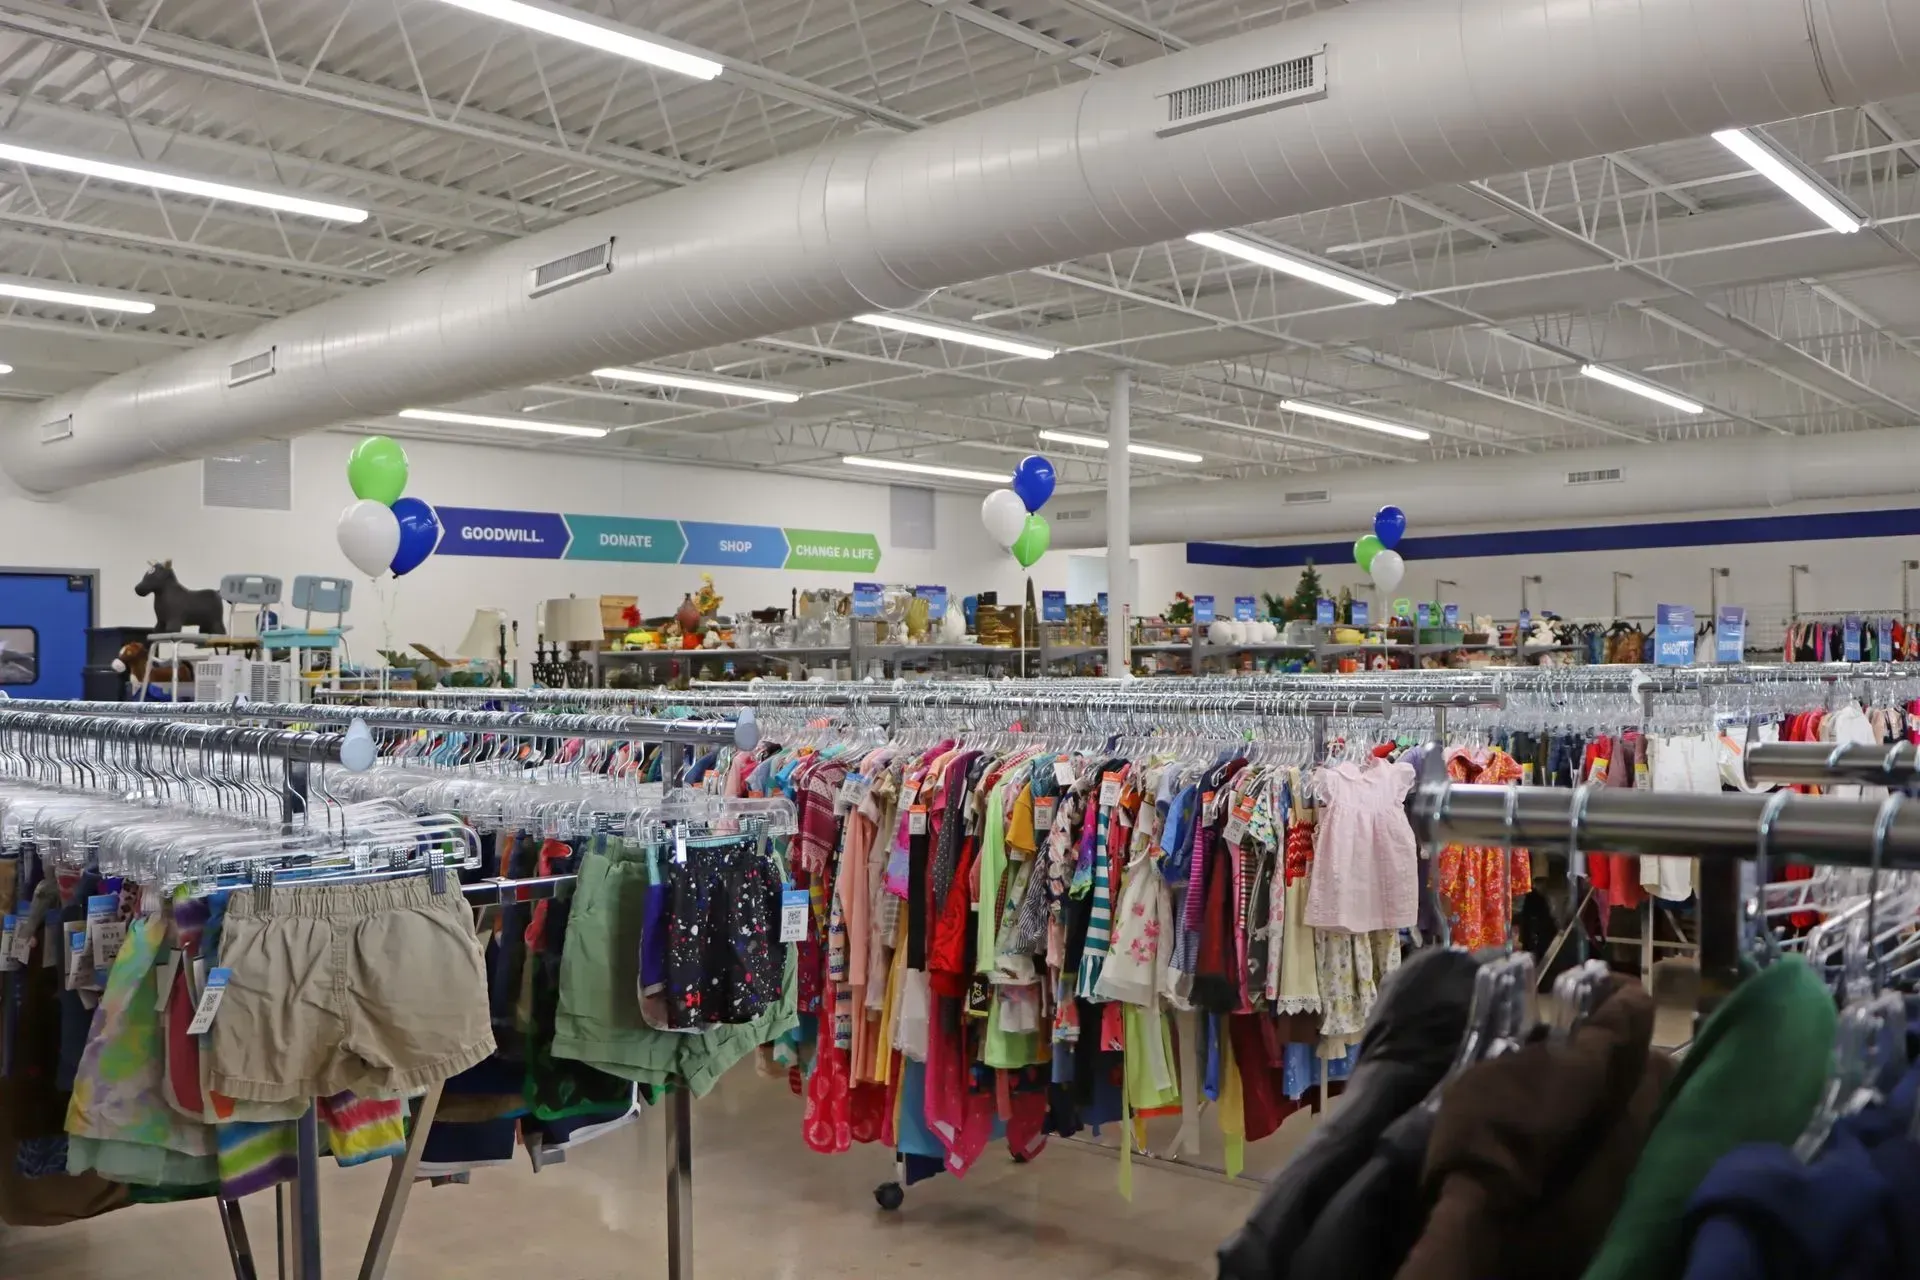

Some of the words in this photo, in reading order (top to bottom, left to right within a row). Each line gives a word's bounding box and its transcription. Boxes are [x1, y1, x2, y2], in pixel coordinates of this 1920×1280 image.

[461, 526, 544, 543] GOODWILL.
[599, 533, 653, 548] DONATE
[719, 540, 753, 553] SHOP
[796, 544, 841, 558] CHANGE
[842, 549, 850, 559] A
[852, 549, 875, 560] LIFE
[1662, 641, 1689, 656] SHORTS
